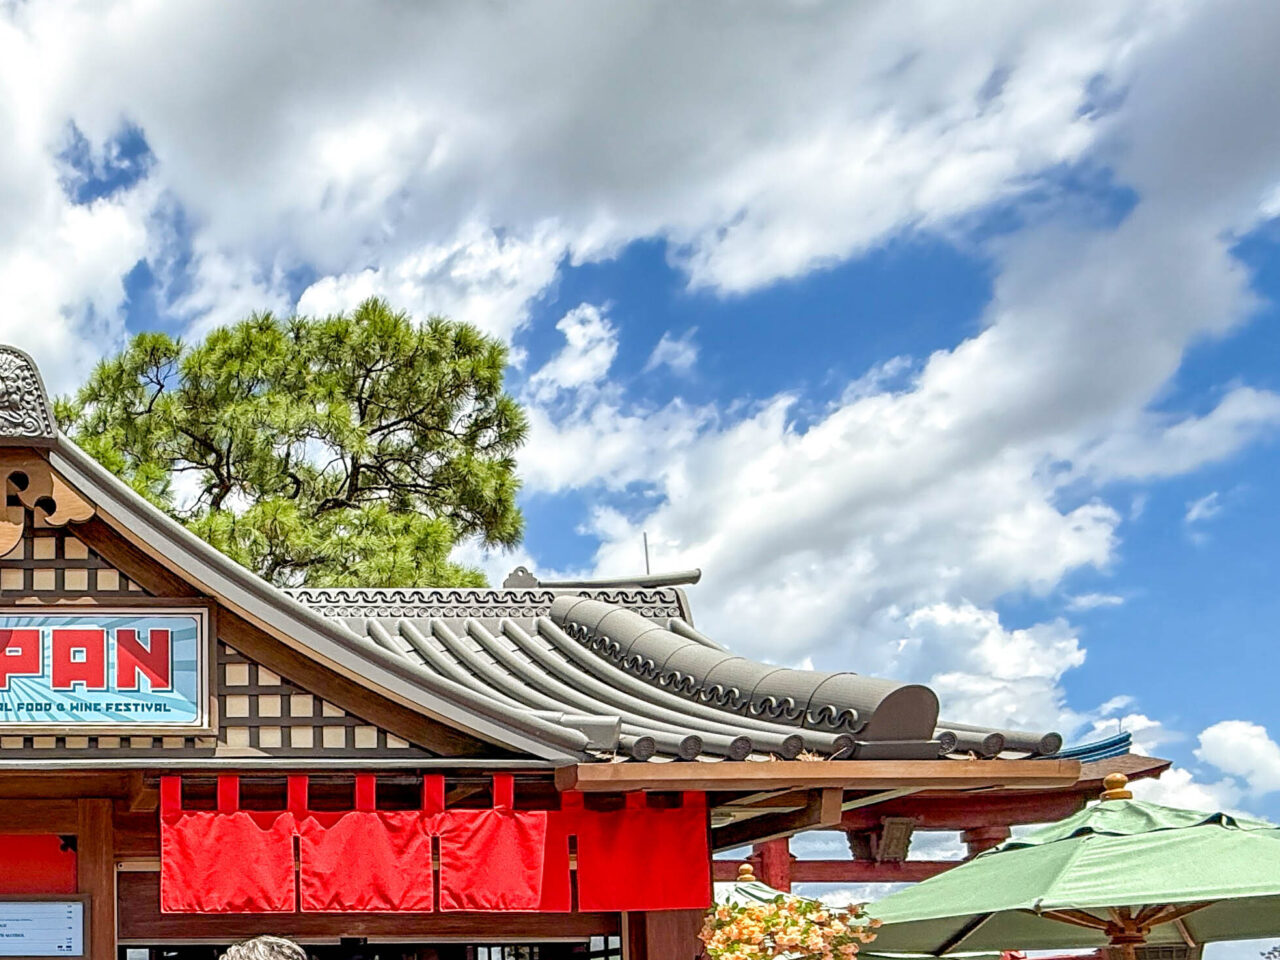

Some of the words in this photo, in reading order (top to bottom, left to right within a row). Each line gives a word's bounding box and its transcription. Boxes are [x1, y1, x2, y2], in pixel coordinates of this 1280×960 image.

[16, 702, 52, 712] FOOD
[56, 703, 66, 712] &
[69, 702, 102, 712] WINE
[105, 702, 172, 712] FESTIVAL
